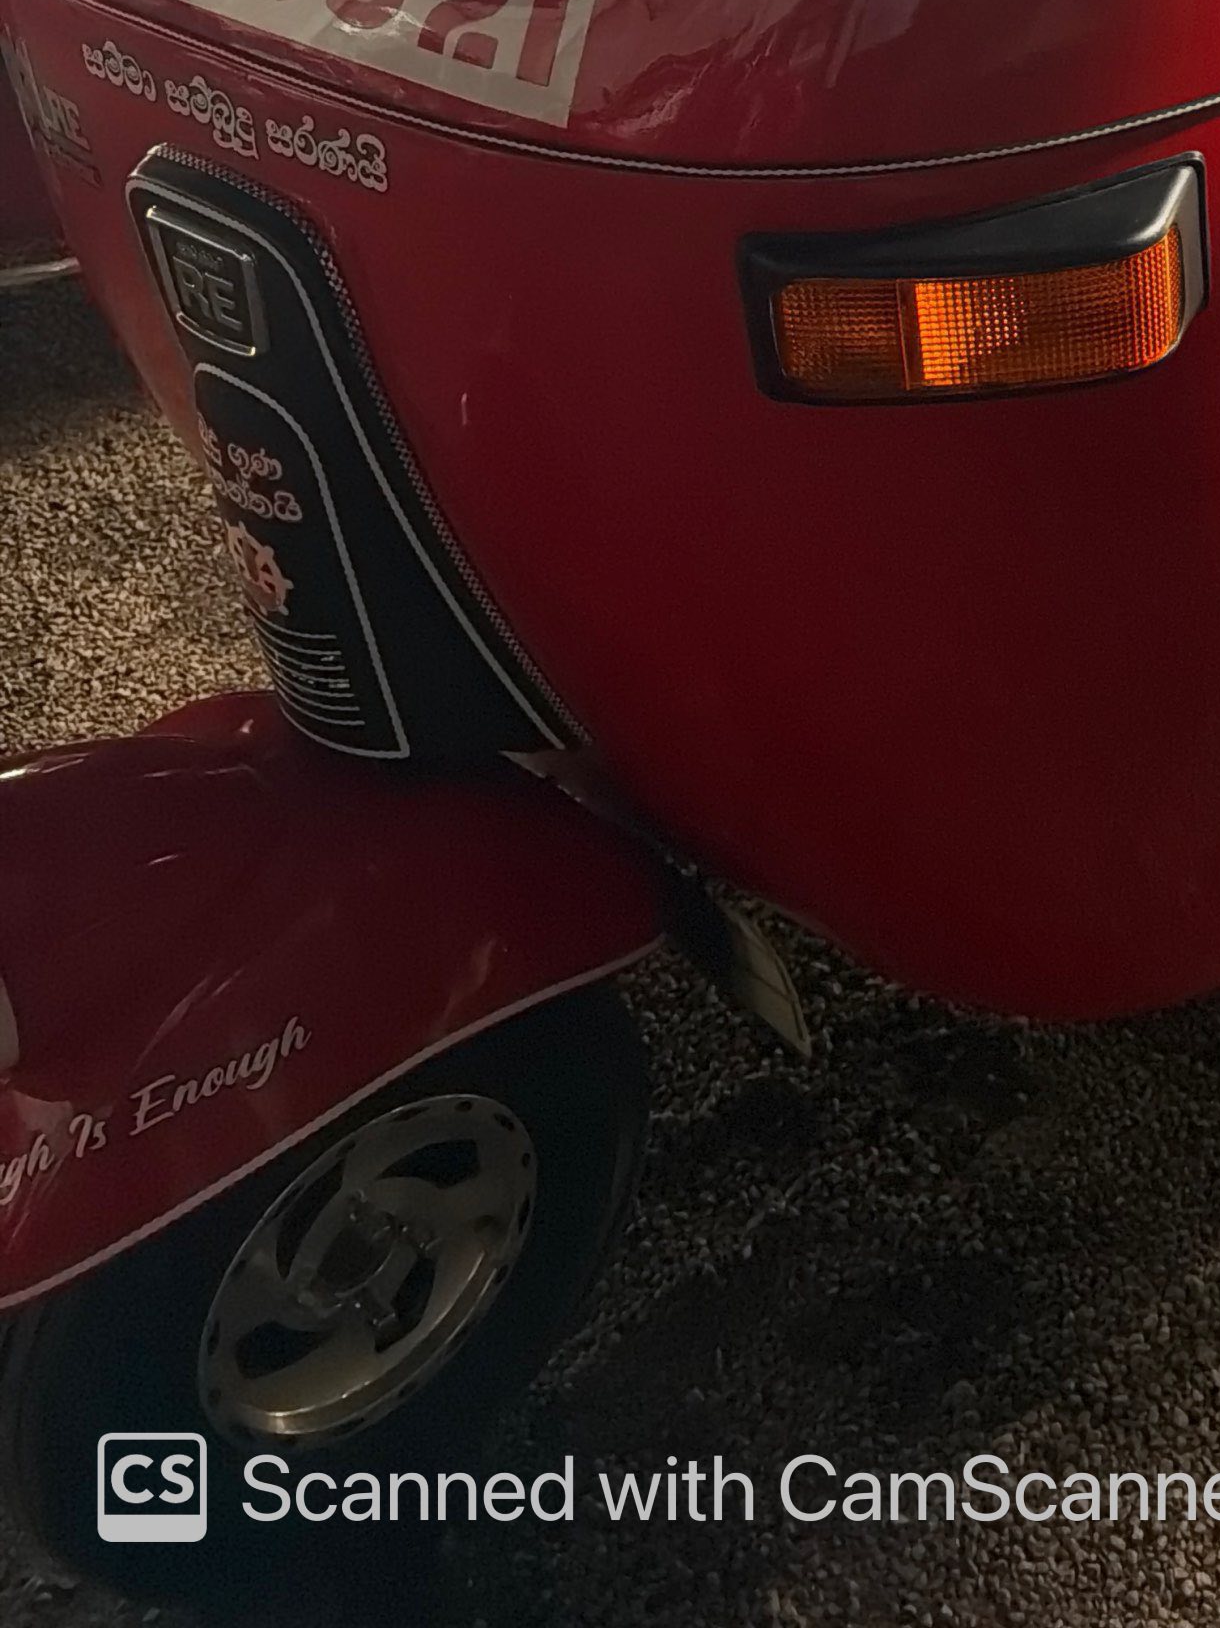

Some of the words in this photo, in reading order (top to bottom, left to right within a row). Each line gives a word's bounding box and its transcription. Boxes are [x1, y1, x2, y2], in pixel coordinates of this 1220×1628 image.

[81, 40, 156, 102] සම්මා
[164, 75, 260, 160] සම්බුදු
[265, 115, 388, 193] සරණයි
[172, 255, 243, 332] RE
[68, 1114, 107, 1159] Is
[128, 1015, 312, 1137] Enough
